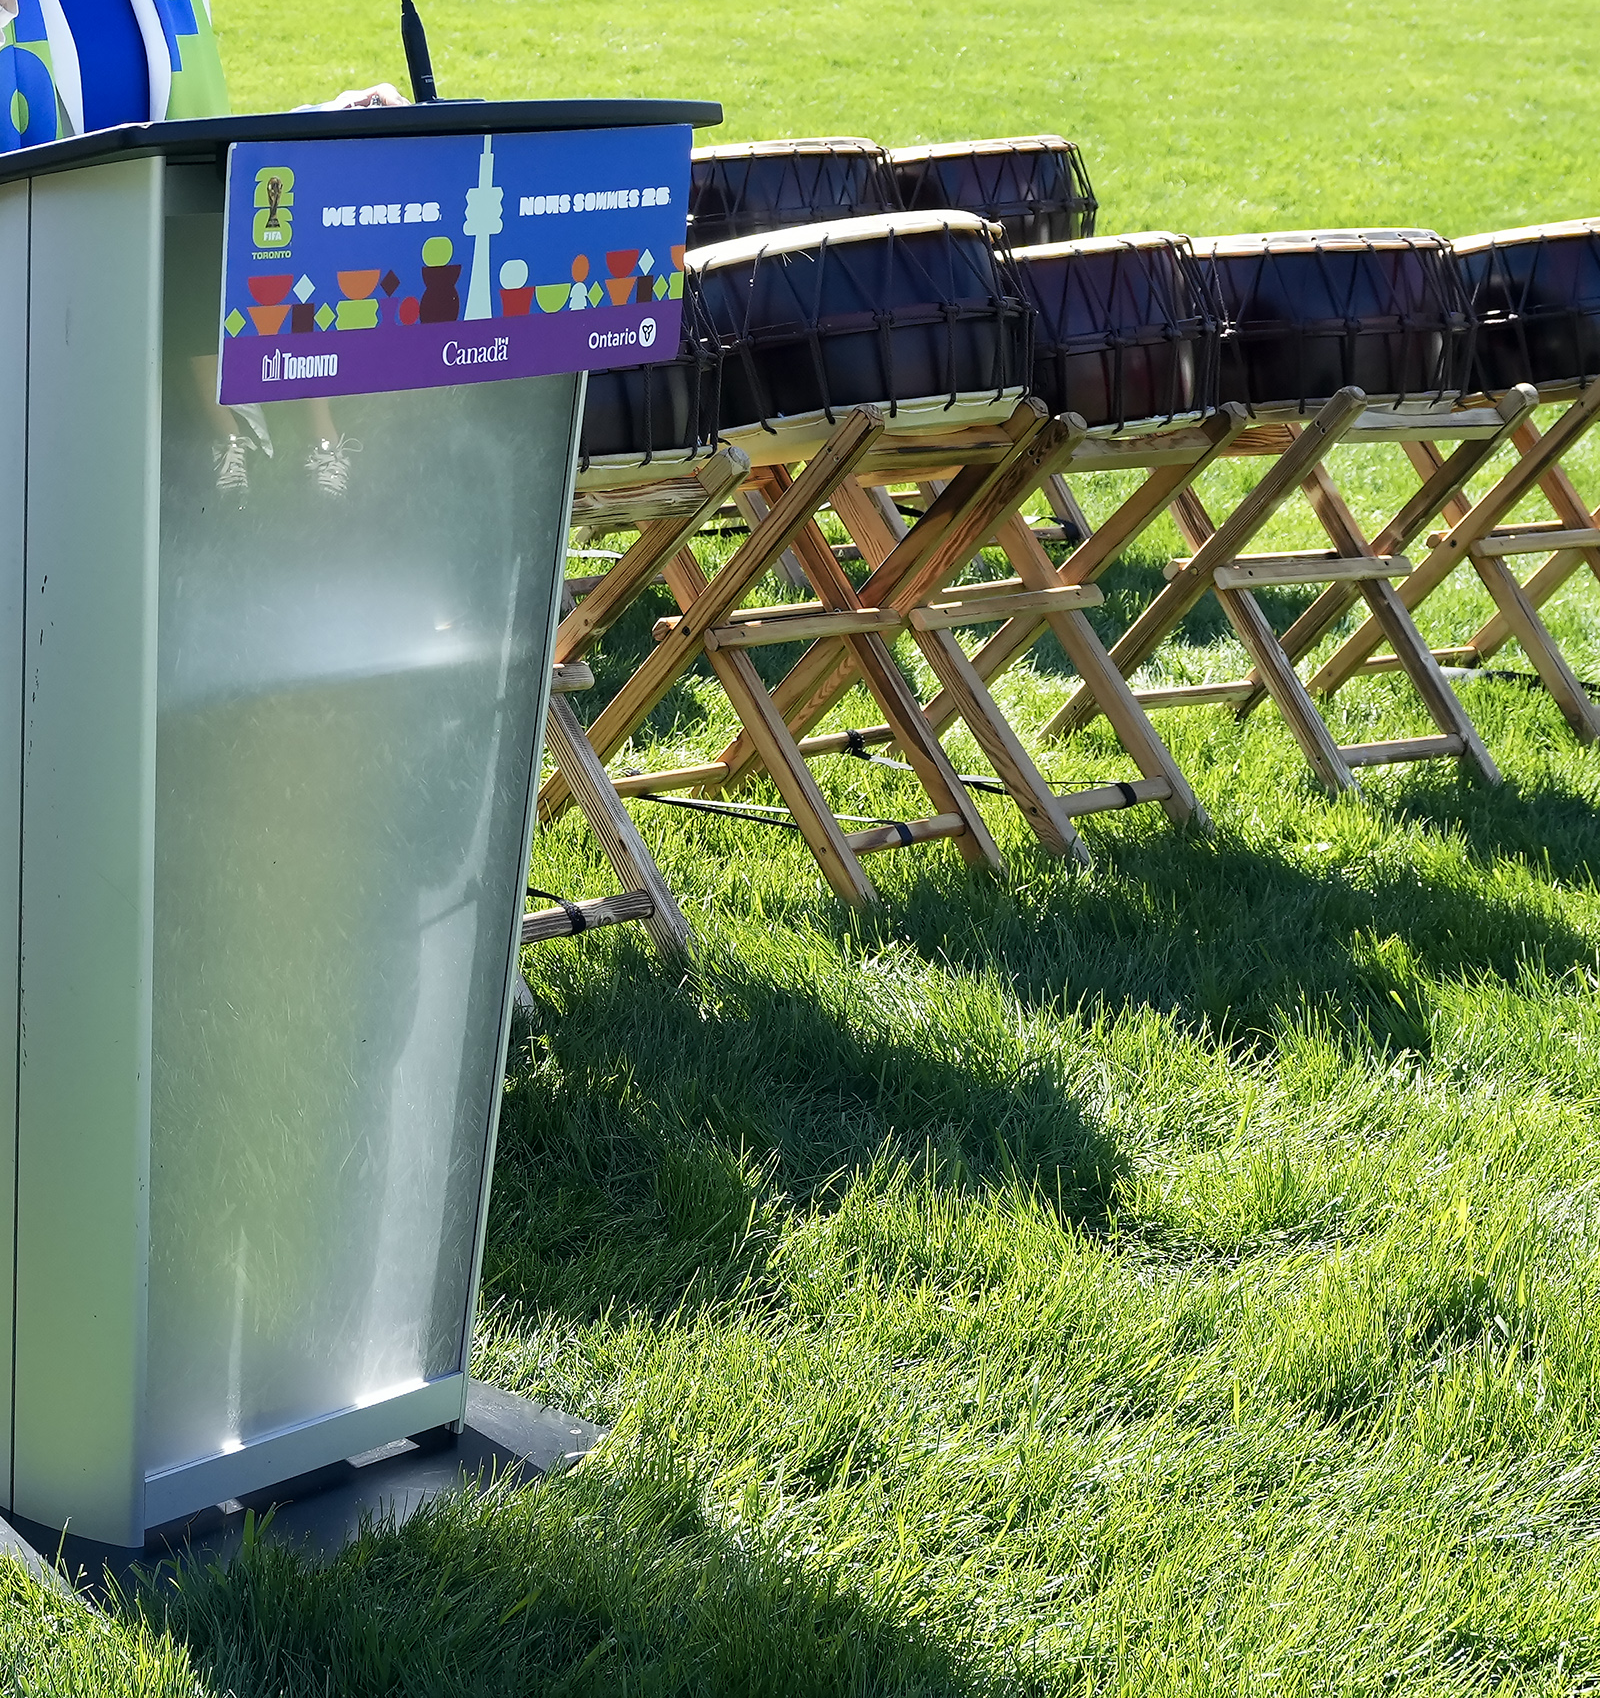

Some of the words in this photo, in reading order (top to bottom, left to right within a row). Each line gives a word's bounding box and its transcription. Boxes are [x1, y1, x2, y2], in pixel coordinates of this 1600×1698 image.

[519, 194, 571, 216] NOUS
[573, 189, 640, 212] SOMMES
[322, 206, 356, 227] WE
[359, 204, 401, 225] ARE
[263, 231, 282, 241] FIFA
[252, 250, 292, 260] TORONTO
[588, 331, 636, 350] Ontario
[442, 338, 509, 367] Canada
[282, 352, 337, 380] TORONTO
